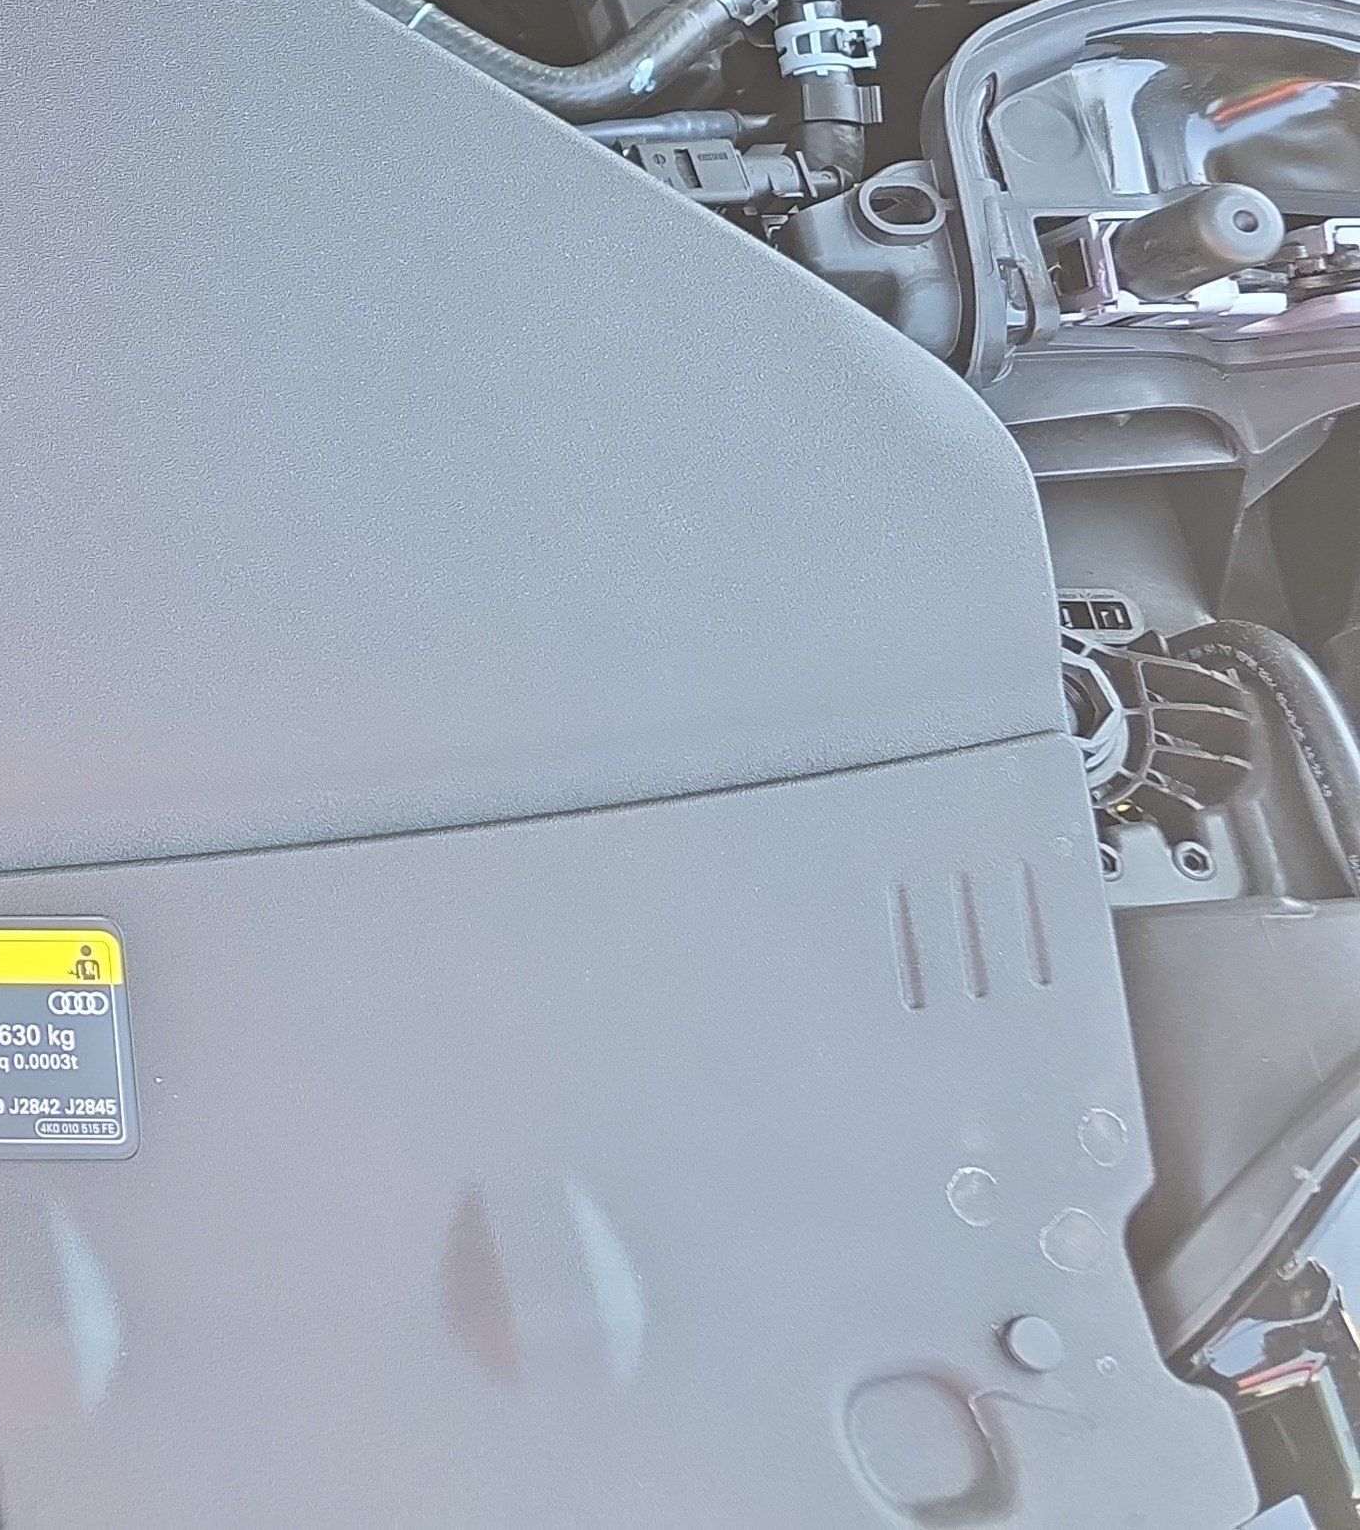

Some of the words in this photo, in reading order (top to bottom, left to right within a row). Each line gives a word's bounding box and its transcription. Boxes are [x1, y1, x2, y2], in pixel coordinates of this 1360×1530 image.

[47, 1024, 75, 1050] kg
[14, 1053, 78, 1070] 0.0003t
[9, 1098, 61, 1115] J2842
[65, 1098, 116, 1116] J2845
[40, 1123, 59, 1133] 4K0
[62, 1123, 79, 1133] 010
[102, 1124, 115, 1134] FE
